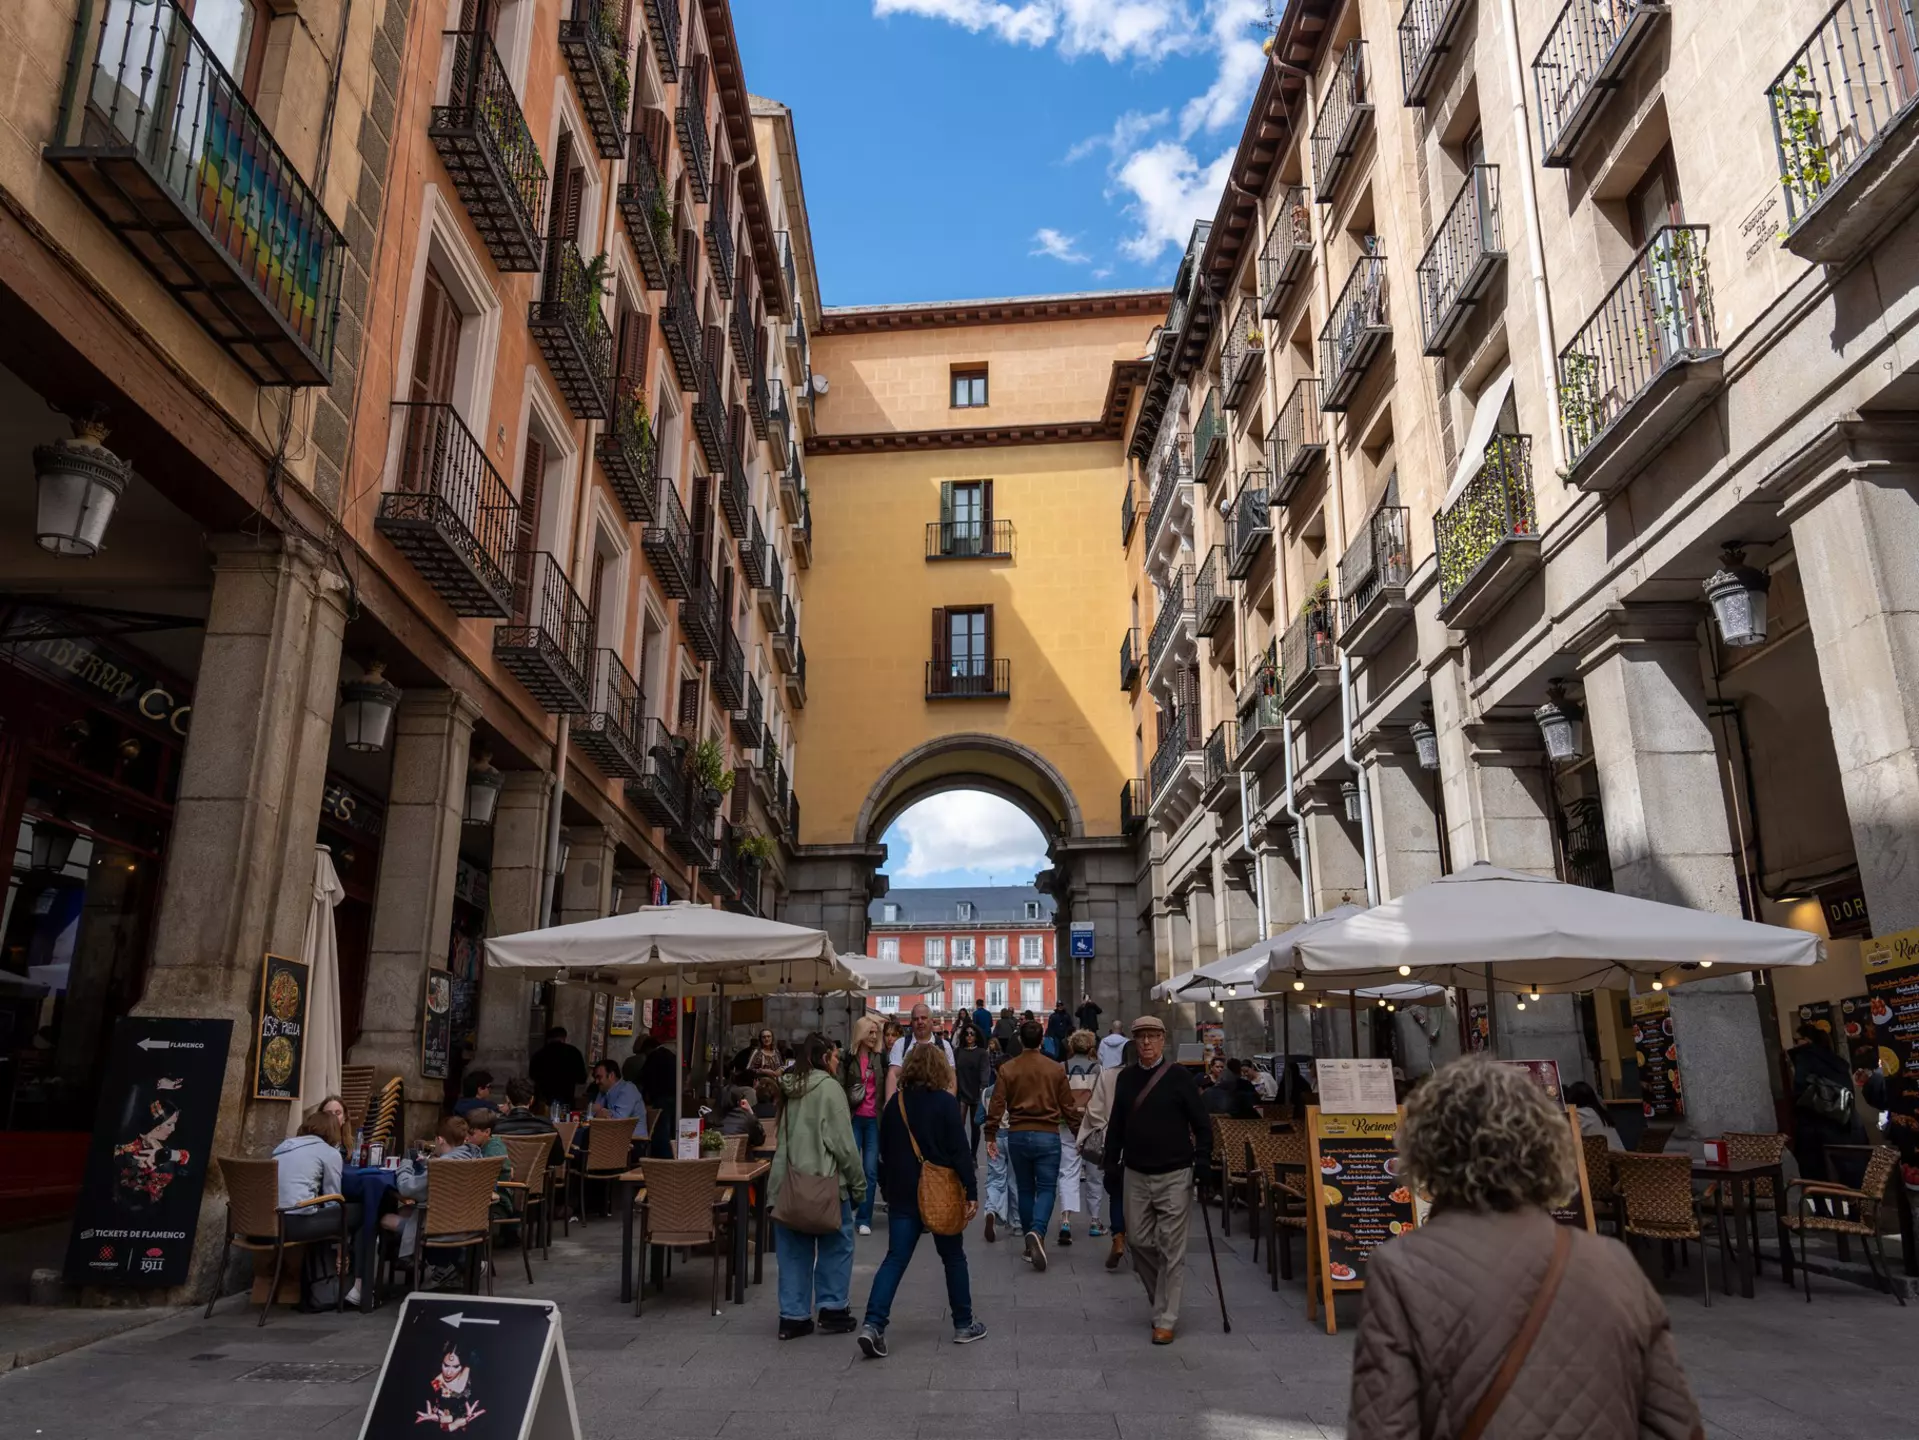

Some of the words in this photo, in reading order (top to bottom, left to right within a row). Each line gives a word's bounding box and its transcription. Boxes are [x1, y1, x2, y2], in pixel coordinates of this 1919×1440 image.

[1756, 220, 1767, 236] DE
[1351, 1117, 1397, 1134] Raciones
[95, 1229, 128, 1238] TICKETS
[129, 1230, 141, 1239] DE
[141, 1230, 186, 1240] FLAMENCO
[140, 1260, 163, 1274] 1911
